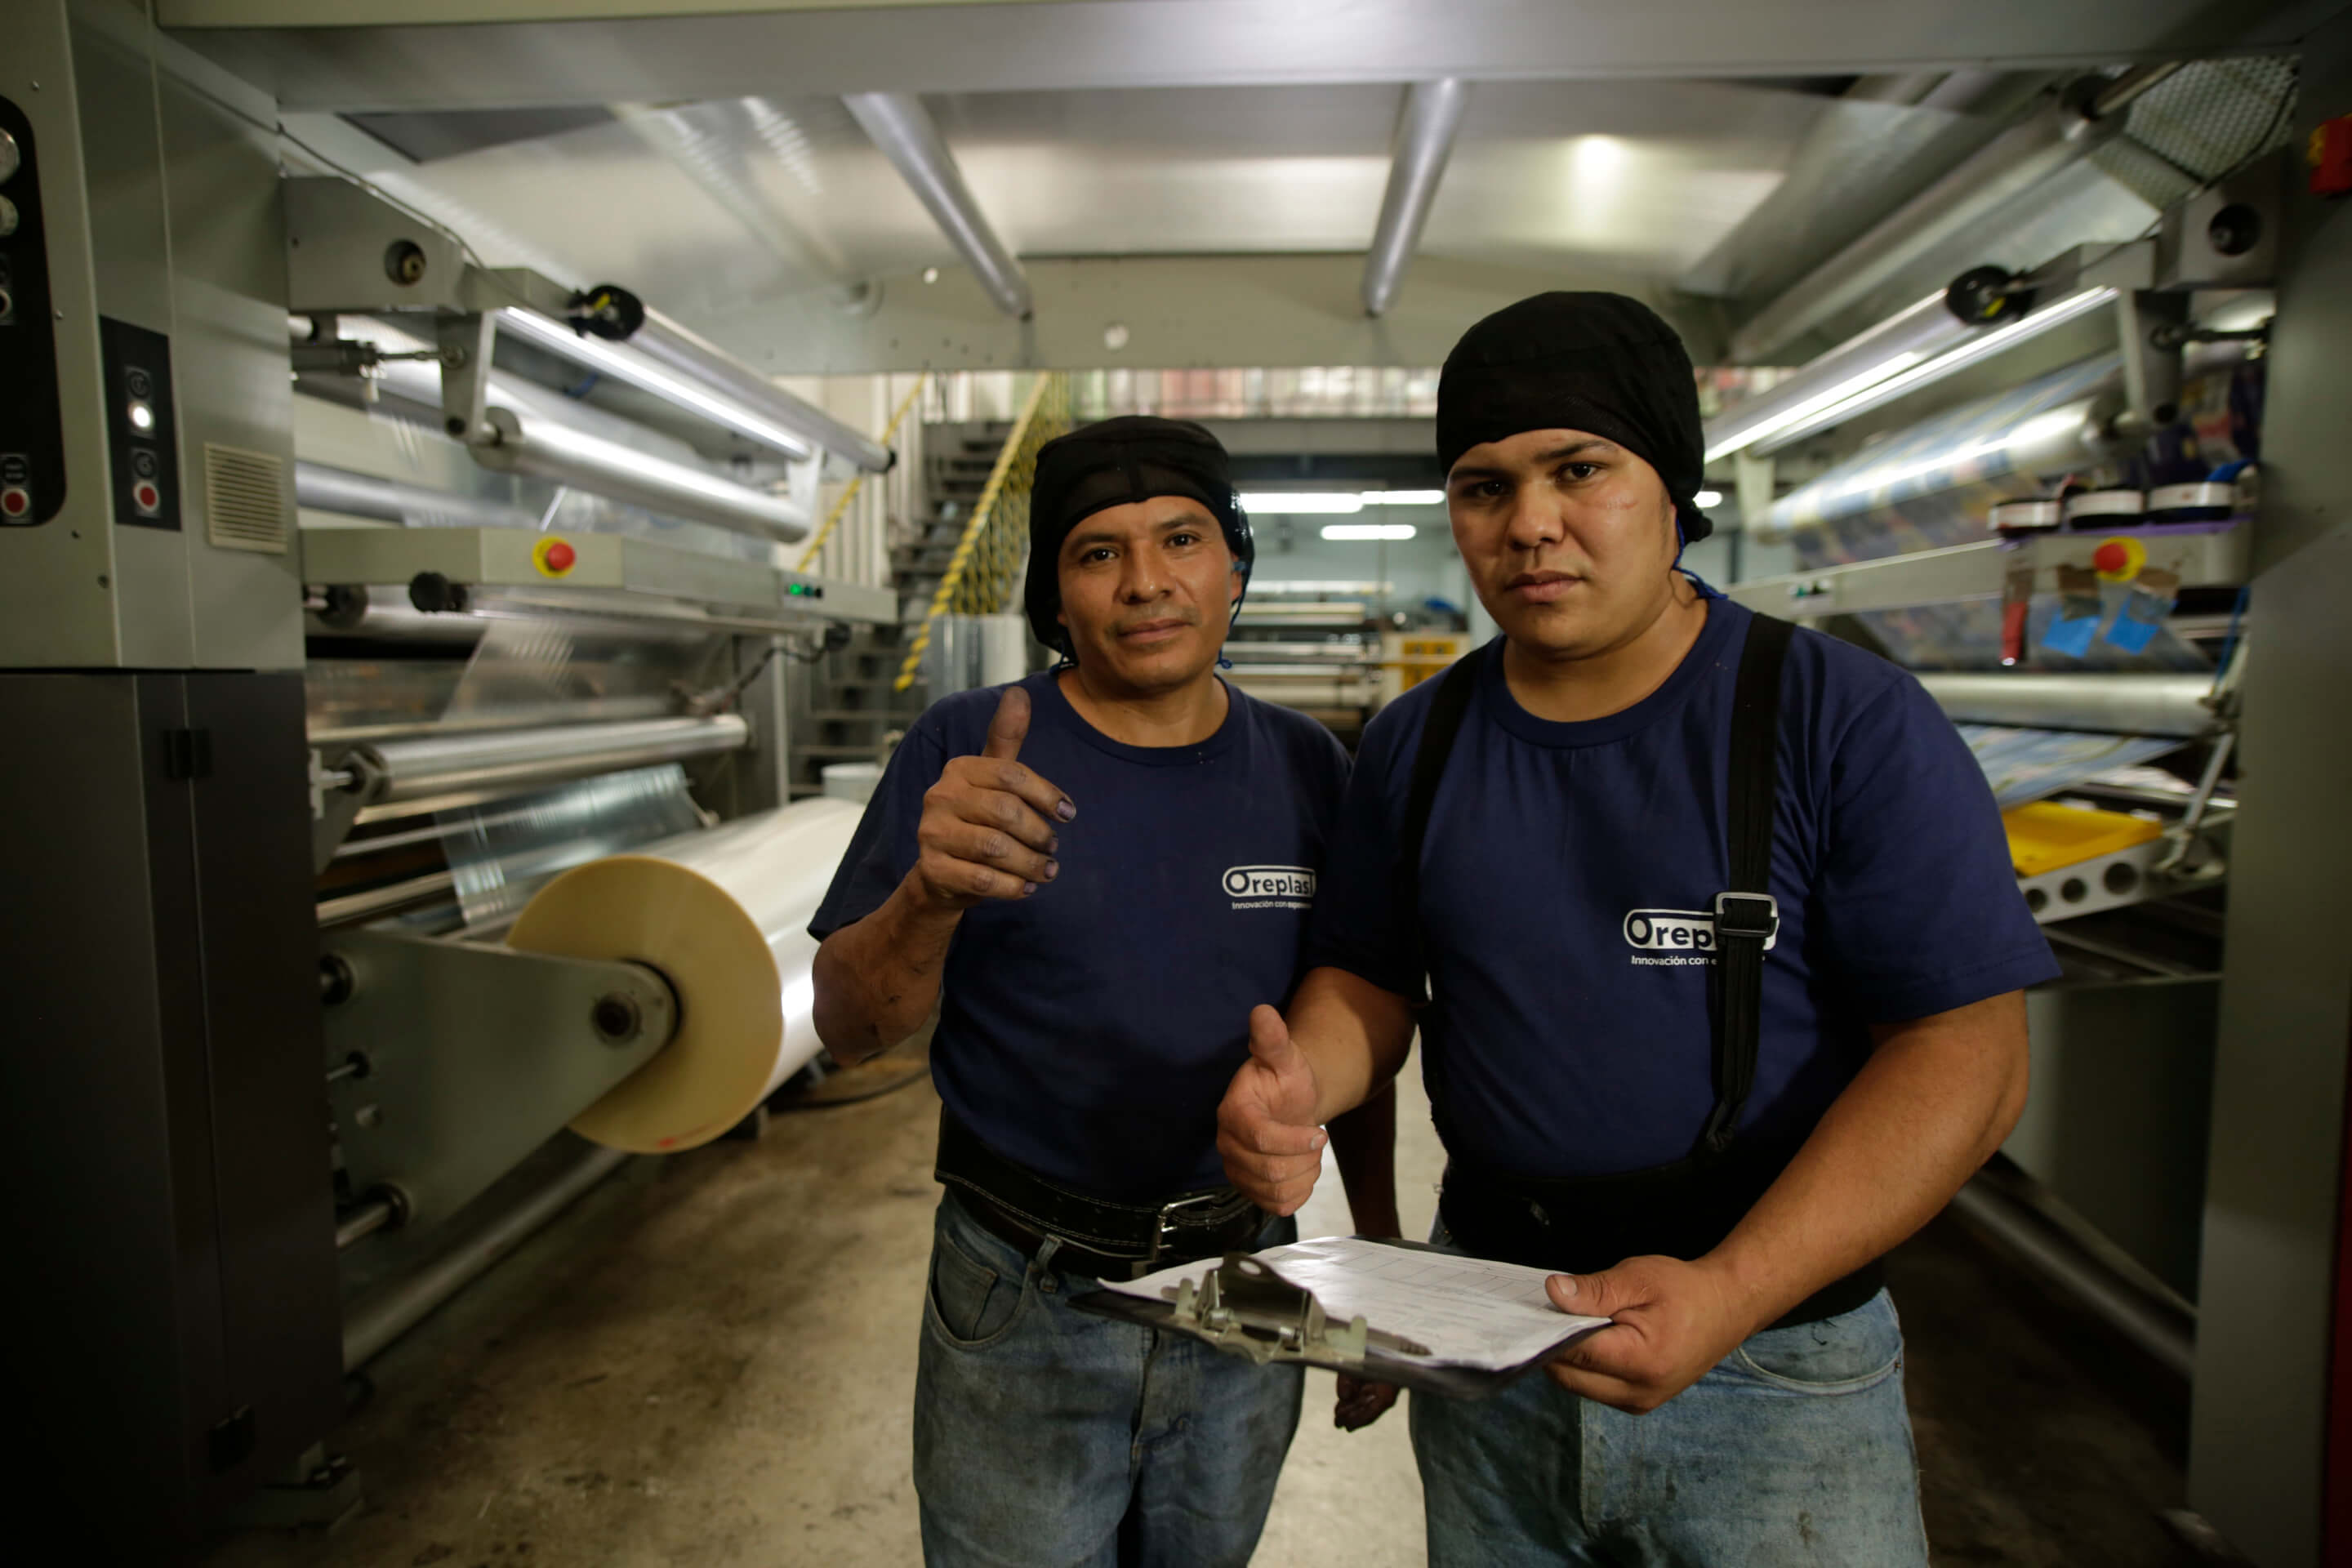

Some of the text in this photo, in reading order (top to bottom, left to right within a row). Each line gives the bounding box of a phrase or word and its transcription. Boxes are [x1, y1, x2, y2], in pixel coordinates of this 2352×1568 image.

[1232, 900, 1274, 910] Innovación
[1627, 913, 1713, 950] Orep
[1631, 955, 1687, 965] Innovación
[1688, 957, 1709, 965] con
